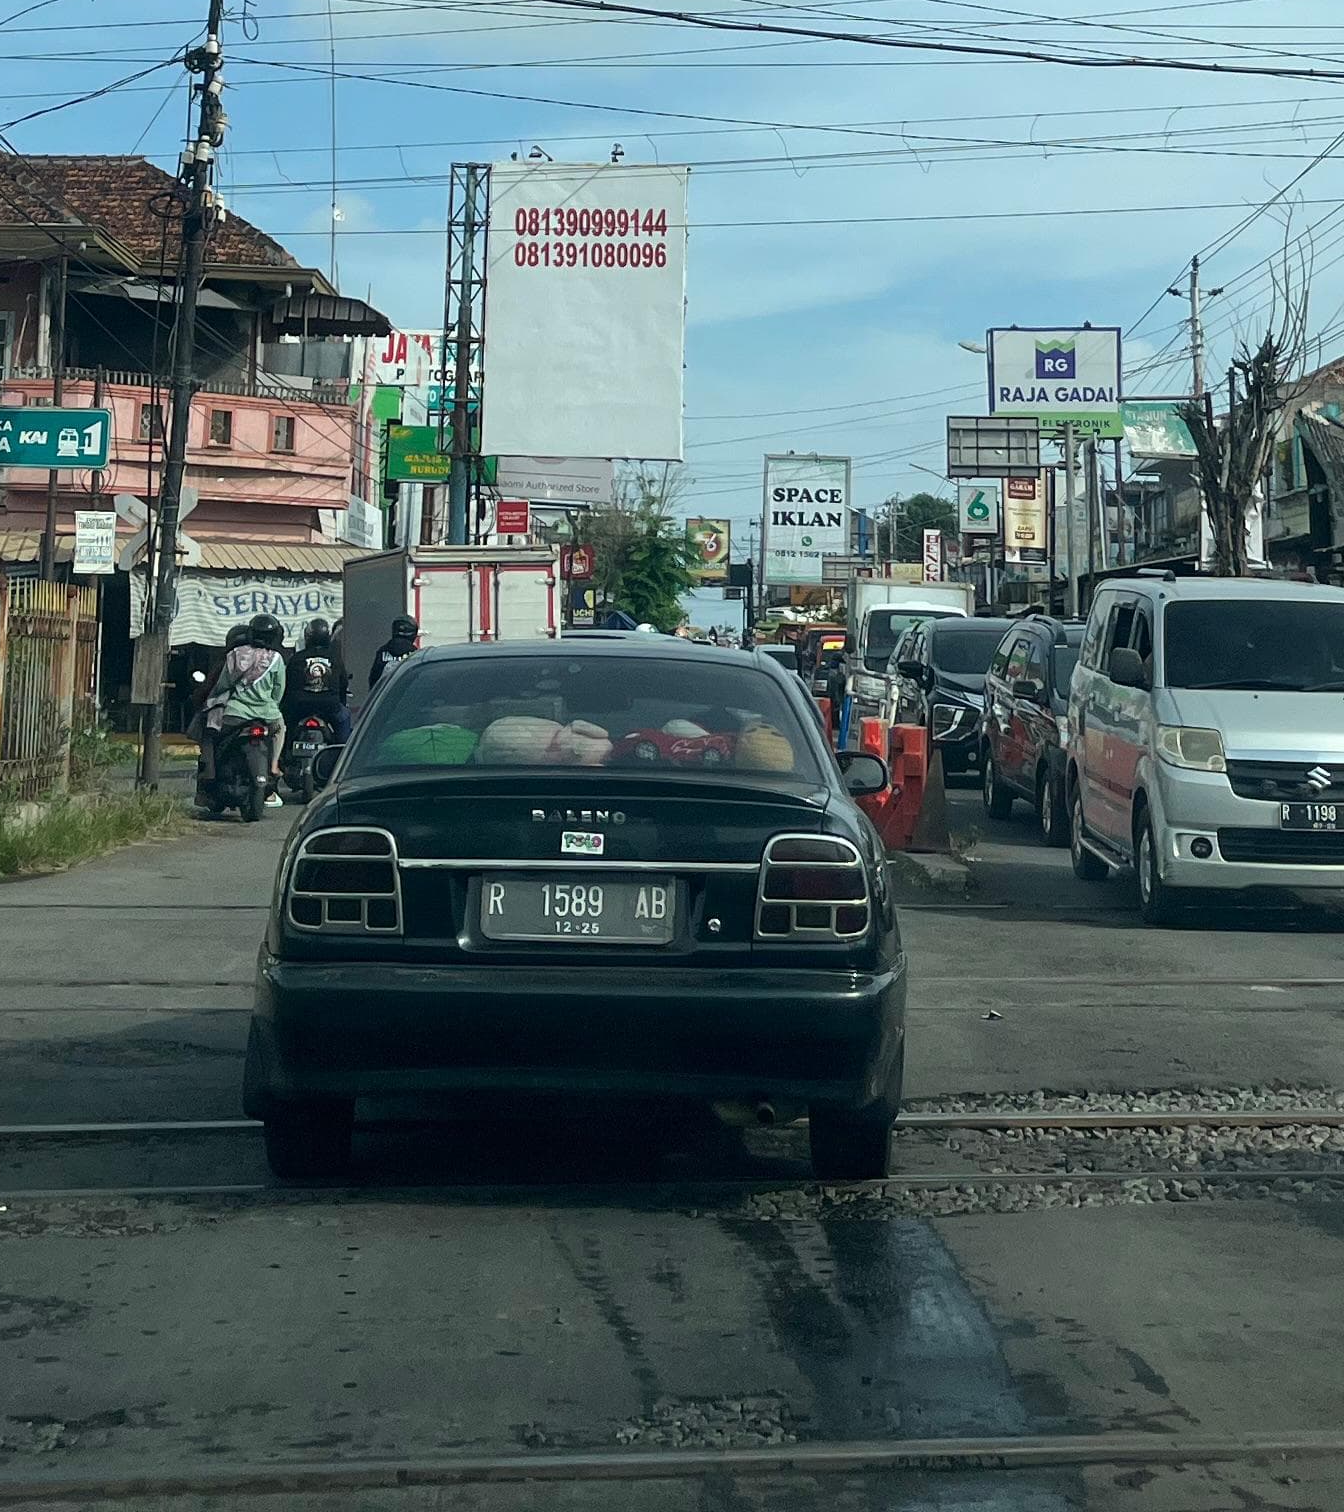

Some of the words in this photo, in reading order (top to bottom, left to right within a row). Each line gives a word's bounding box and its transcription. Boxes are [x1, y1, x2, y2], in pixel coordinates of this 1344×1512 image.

[515, 208, 667, 236] 081390999144
[514, 242, 667, 267] 081391080096
[1044, 359, 1068, 372] RG
[999, 387, 1049, 402] RAJA
[1055, 387, 1113, 402] GADAI
[19, 430, 49, 445] KAI
[576, 484, 600, 494] Store
[772, 487, 842, 504] SPACE
[772, 511, 842, 527] IKLAN
[1282, 804, 1290, 821] R
[1306, 805, 1336, 822] 1198
[488, 883, 505, 915] R
[542, 884, 604, 917] 1589
[634, 886, 667, 919] AB
